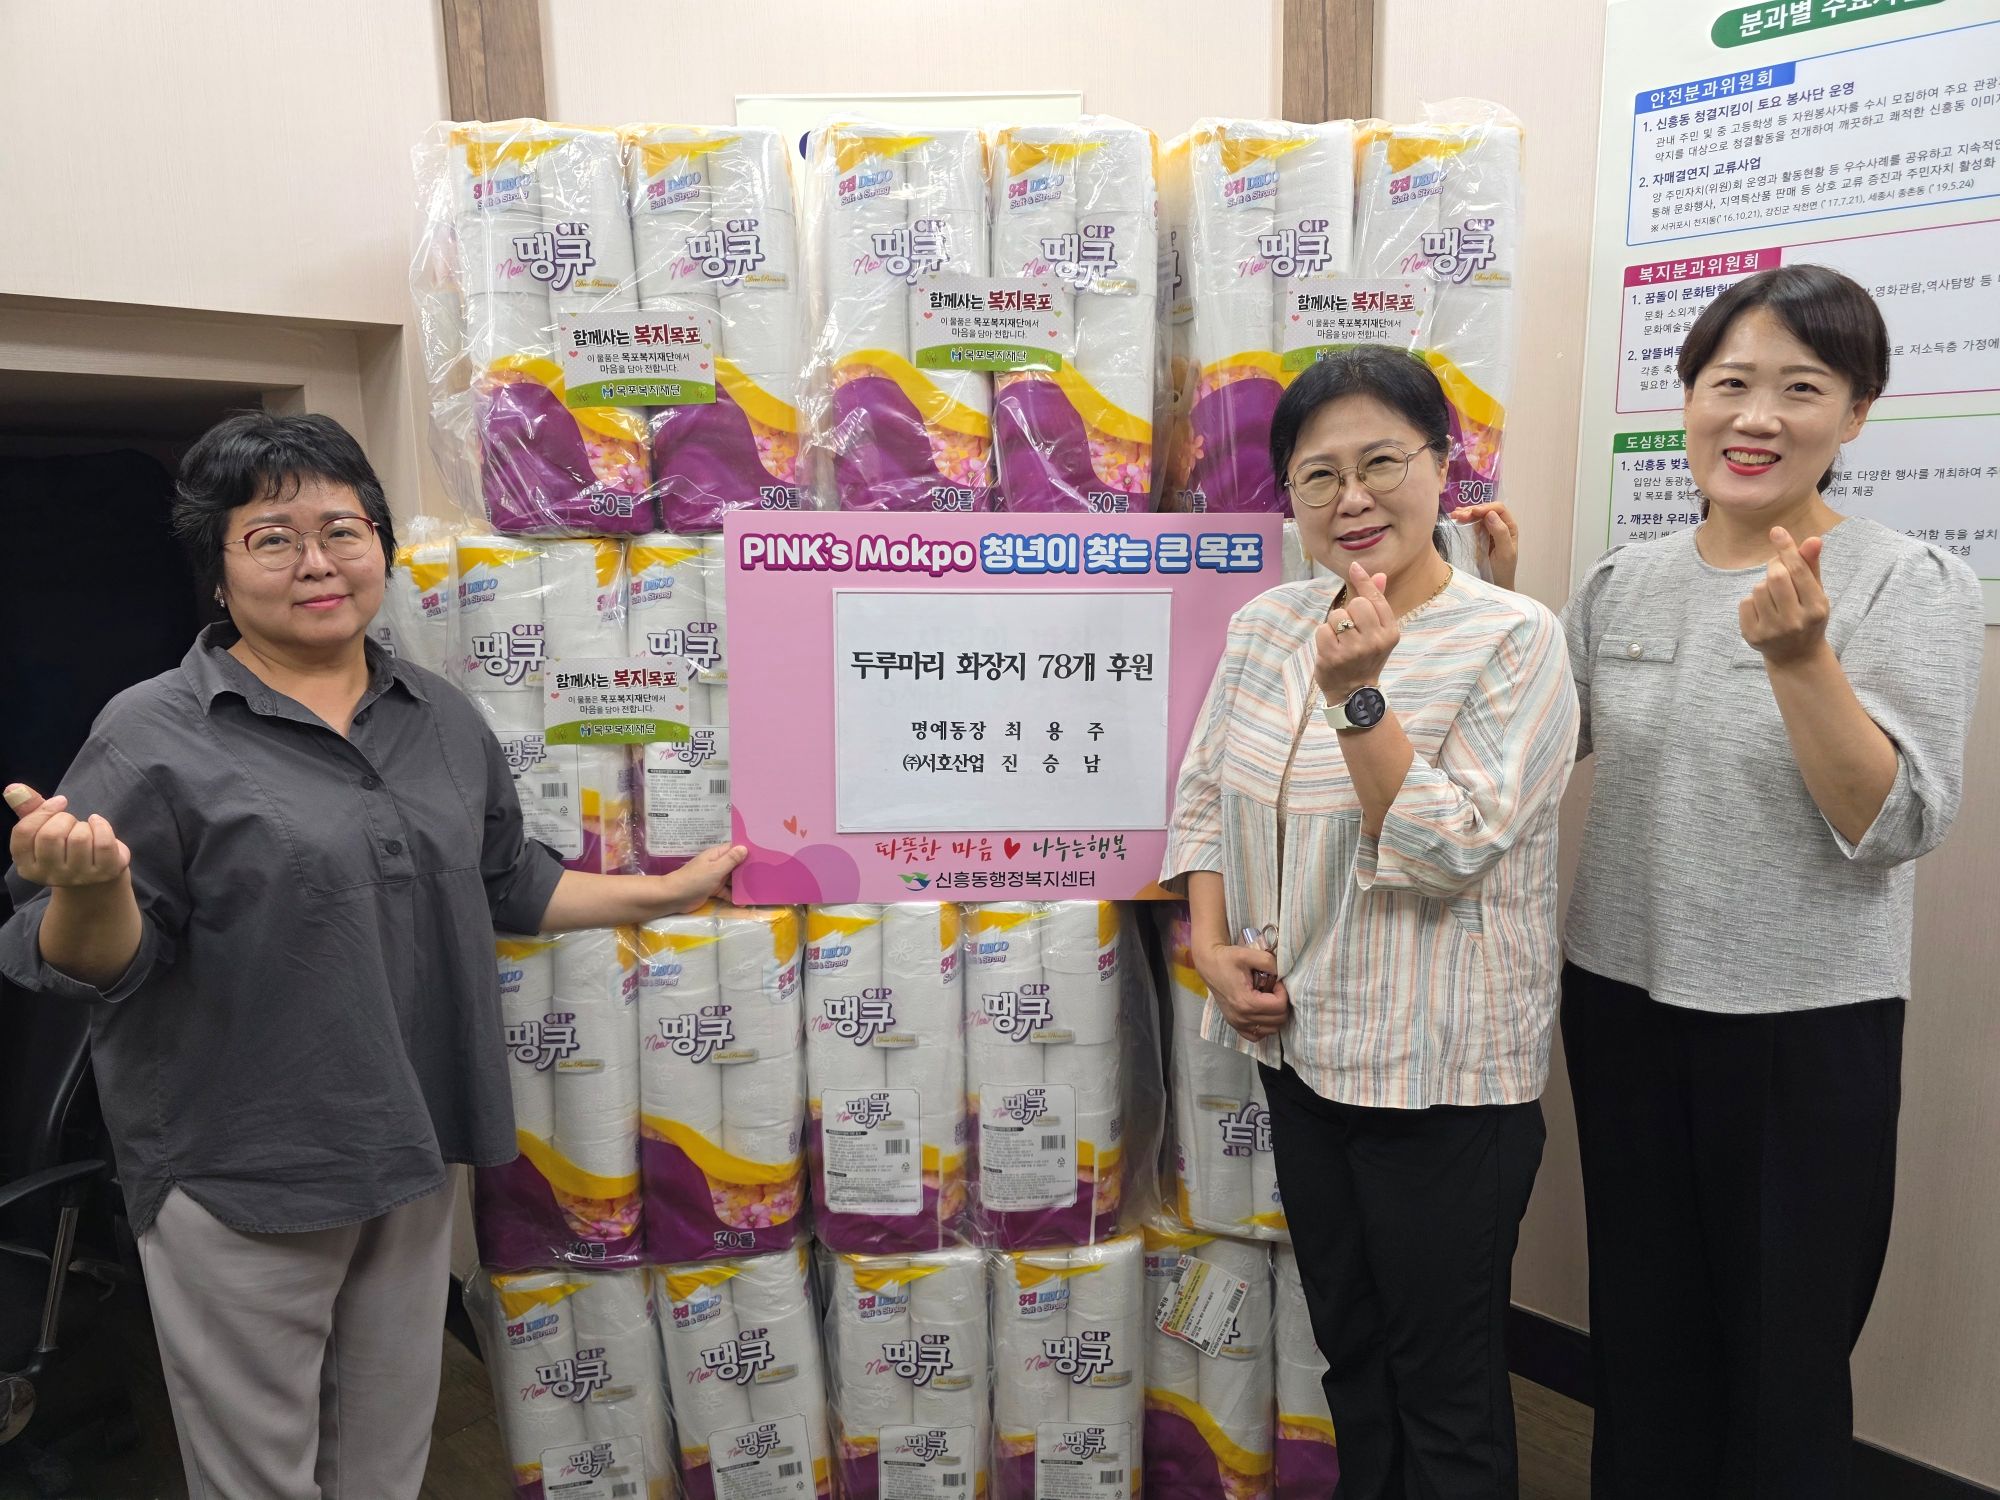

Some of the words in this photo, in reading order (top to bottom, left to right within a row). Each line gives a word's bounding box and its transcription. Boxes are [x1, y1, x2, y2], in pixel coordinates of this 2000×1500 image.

[1739, 0, 1811, 38] 분과별
[1650, 69, 1773, 109] 안전분과위원회
[1643, 121, 1652, 132] 1.
[1656, 113, 1690, 131] 신흥동
[1695, 101, 1753, 124] 청결지킴이
[1757, 95, 1782, 111] 토요
[1786, 89, 1825, 106] 봉사단
[1829, 81, 1855, 98] 운영
[1656, 137, 1675, 148] 관내
[1679, 131, 1699, 144] 주민
[1703, 128, 1713, 139] 및
[1730, 117, 1773, 134] 고등학생
[1777, 115, 1787, 126] 등
[1792, 101, 1860, 122] 자원봉사자를
[1864, 95, 1887, 110] 수시
[1892, 87, 1939, 105] 모집하여
[1944, 82, 1968, 97] 주요
[1656, 149, 1684, 162] 약지를
[1689, 141, 1728, 156] 대상으로
[1733, 130, 1785, 149] 청결활동을
[1790, 123, 1833, 139] 전개하여
[1839, 113, 1885, 130] 깨끗하고
[1889, 106, 1924, 122] 쾌적한
[1929, 100, 1965, 116] 신흥동
[1639, 178, 1649, 188] 2.
[1653, 166, 1709, 186] 자매결연지
[1714, 157, 1762, 176] 교류사업
[1746, 174, 1777, 188] 운영과
[1781, 166, 1825, 183] 활동현황
[1829, 164, 1839, 176] 등
[1844, 154, 1901, 172] 우수사례를
[1905, 147, 1952, 164] 공유하고
[1391, 193, 1408, 205] Soft
[1411, 191, 1418, 201] &
[1419, 185, 1444, 200] Strong
[1652, 205, 1670, 218] 통해
[1720, 191, 1771, 207] 지역특산품
[1776, 187, 1796, 200] 판매
[1801, 184, 1811, 195] 등
[1815, 181, 1837, 194] 상호
[1841, 176, 1863, 189] 교류
[1868, 170, 1902, 186] 증진과
[1907, 162, 1954, 179] 주민자치
[1959, 156, 1996, 173] 활성화
[725, 219, 759, 234] CIP
[1083, 224, 1115, 239] CIP
[1299, 219, 1330, 233] CIP
[1464, 218, 1495, 232] CIP
[513, 231, 596, 291] 땡큐
[685, 230, 765, 285] 땡큐
[1041, 233, 1118, 290] 땡큐
[1258, 229, 1332, 279] 땡큐
[1421, 227, 1496, 285] 땡큐
[1638, 253, 1759, 282] 복지분과위원회
[929, 292, 984, 310] 함께사는
[987, 290, 1053, 311] 복지목포
[1298, 294, 1348, 311] 함께사는
[1352, 291, 1416, 313] 복지목포
[1632, 295, 1641, 305] 1.
[1645, 289, 1678, 304] 꿈돌이
[941, 317, 948, 326] 이
[973, 317, 1039, 328] 목포복지재단에서
[1644, 310, 1663, 321] 문화
[573, 329, 630, 347] 함께사는
[634, 323, 702, 345] 복지목포
[952, 328, 976, 338] 마음을
[587, 354, 595, 363] 이
[621, 352, 690, 363] 목포복지재단에서
[965, 350, 1028, 362] 목포복지재단
[1910, 341, 1957, 355] 저소득층
[600, 365, 626, 375] 마음을
[1640, 365, 1659, 376] 각종
[616, 385, 681, 397] 목포복지재단
[1640, 379, 1668, 391] 필요한
[1621, 461, 1630, 471] 1.
[1633, 459, 1666, 471] 신흥동
[1857, 469, 1891, 481] 다양한
[1895, 468, 1929, 480] 행사를
[1934, 466, 1981, 479] 개최하여
[931, 487, 974, 511] 30롤
[1645, 490, 1673, 501] 목포를
[1852, 486, 1874, 497] 제공
[589, 492, 633, 518] 30롤
[1088, 492, 1129, 513] 30롤
[1617, 514, 1626, 525] 2.
[1630, 513, 1663, 524] 깨끗한
[1944, 529, 1968, 540] 등을
[858, 536, 976, 577] Mokpo
[980, 533, 1080, 573] 청년이
[1085, 533, 1151, 573] 찾는
[1155, 533, 1193, 573] 큰
[1196, 533, 1263, 573] 목포
[511, 624, 545, 637] CIP
[472, 631, 548, 686] 땡큐
[850, 651, 944, 681] 두루마리
[956, 651, 1027, 682] 화장지
[1037, 652, 1096, 682] 78개
[1106, 652, 1154, 682] 후원
[556, 673, 610, 689] 함께사는
[613, 669, 679, 689] 복지목포
[594, 724, 656, 736] 목포복지재단
[911, 721, 987, 742] 명예동장
[1004, 721, 1022, 741] 최
[1046, 721, 1064, 741] 용
[1087, 722, 1105, 741] 주
[1001, 754, 1018, 773] 진
[1042, 754, 1060, 773] 승
[1084, 754, 1101, 773] 남
[874, 838, 942, 862] 따뜻한
[951, 838, 993, 861] 마음
[936, 870, 1096, 889] 신흥동행정복지센터
[1020, 983, 1050, 996] CIP
[543, 1012, 576, 1025] CIP
[700, 1005, 732, 1018] CIP
[824, 995, 896, 1046] 땡큐
[983, 991, 1053, 1042] 땡큐
[505, 1020, 580, 1072] 땡큐
[659, 1013, 735, 1063] 땡큐
[714, 1231, 755, 1249] 30롤
[738, 1328, 768, 1342] CIP
[920, 1333, 950, 1346] CIP
[1081, 1330, 1111, 1343] CIP
[700, 1339, 774, 1385] 땡큐
[882, 1339, 953, 1386] 땡큐
[1042, 1336, 1113, 1384] 땡큐
[535, 1357, 612, 1403] 땡큐
